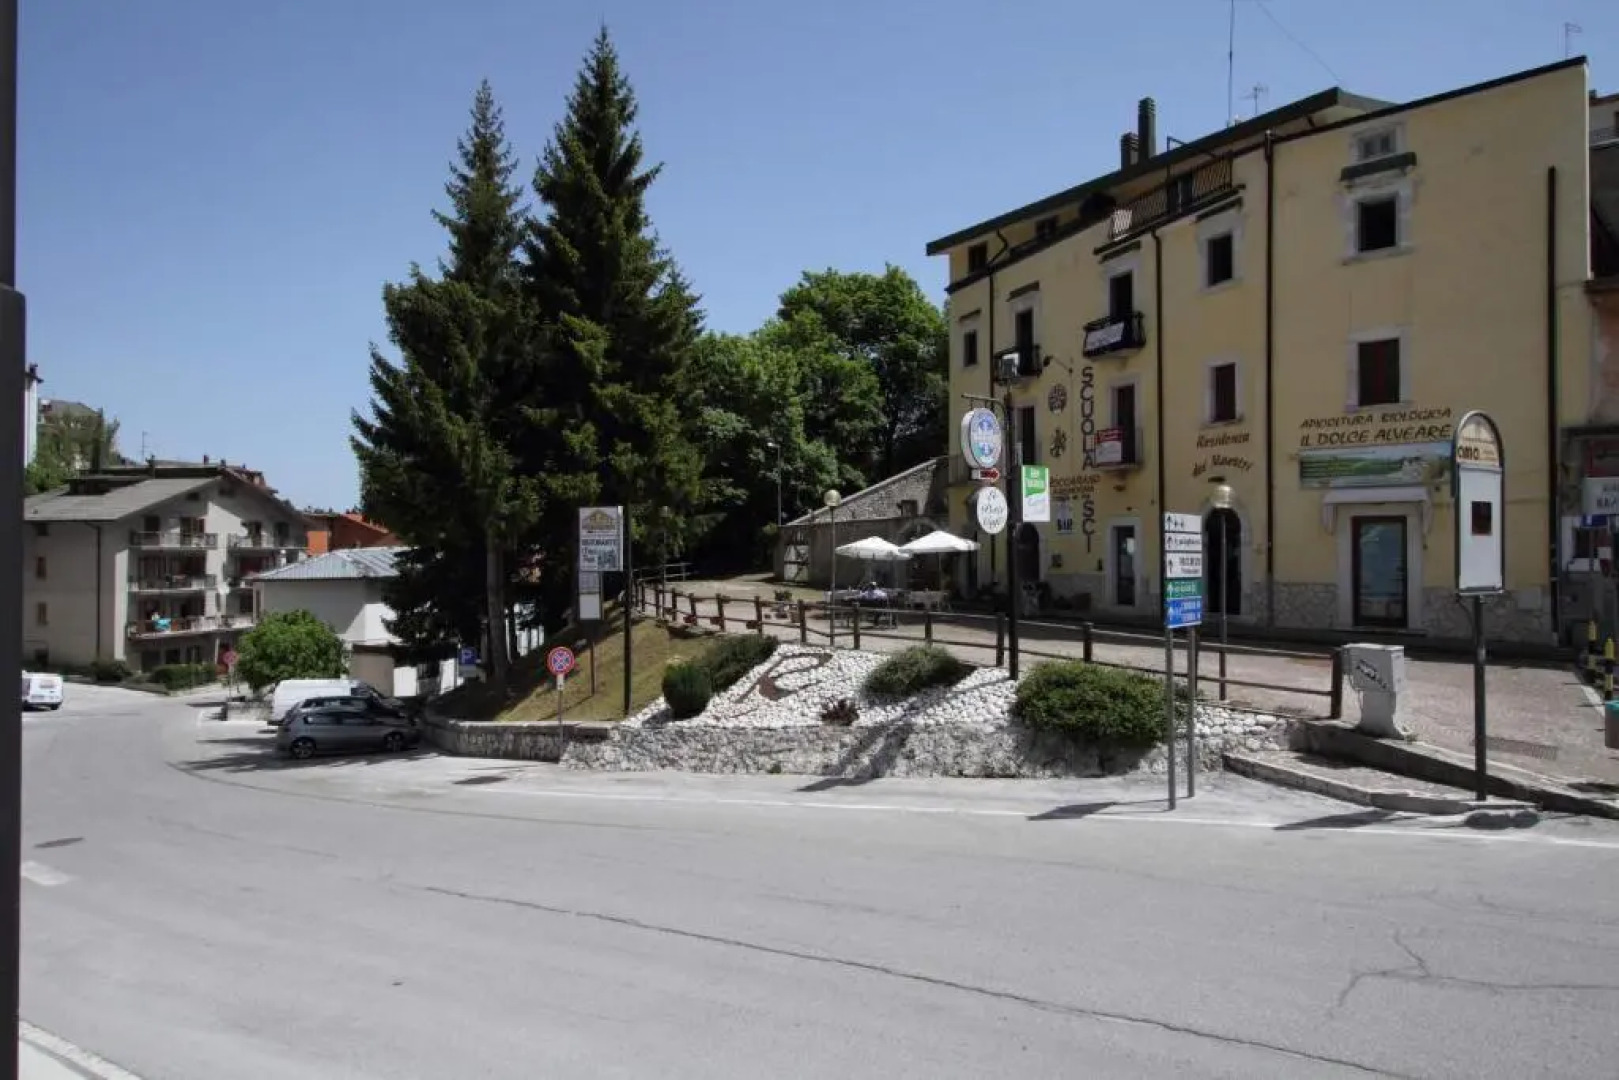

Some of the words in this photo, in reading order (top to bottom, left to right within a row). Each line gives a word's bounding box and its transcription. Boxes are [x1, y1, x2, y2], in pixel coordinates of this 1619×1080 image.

[1080, 366, 1096, 472] SCUOLA
[1300, 435, 1310, 446] IL
[1318, 430, 1370, 445] DOLCE
[1374, 424, 1452, 442] ALVEARE
[1082, 500, 1096, 553] SCI
